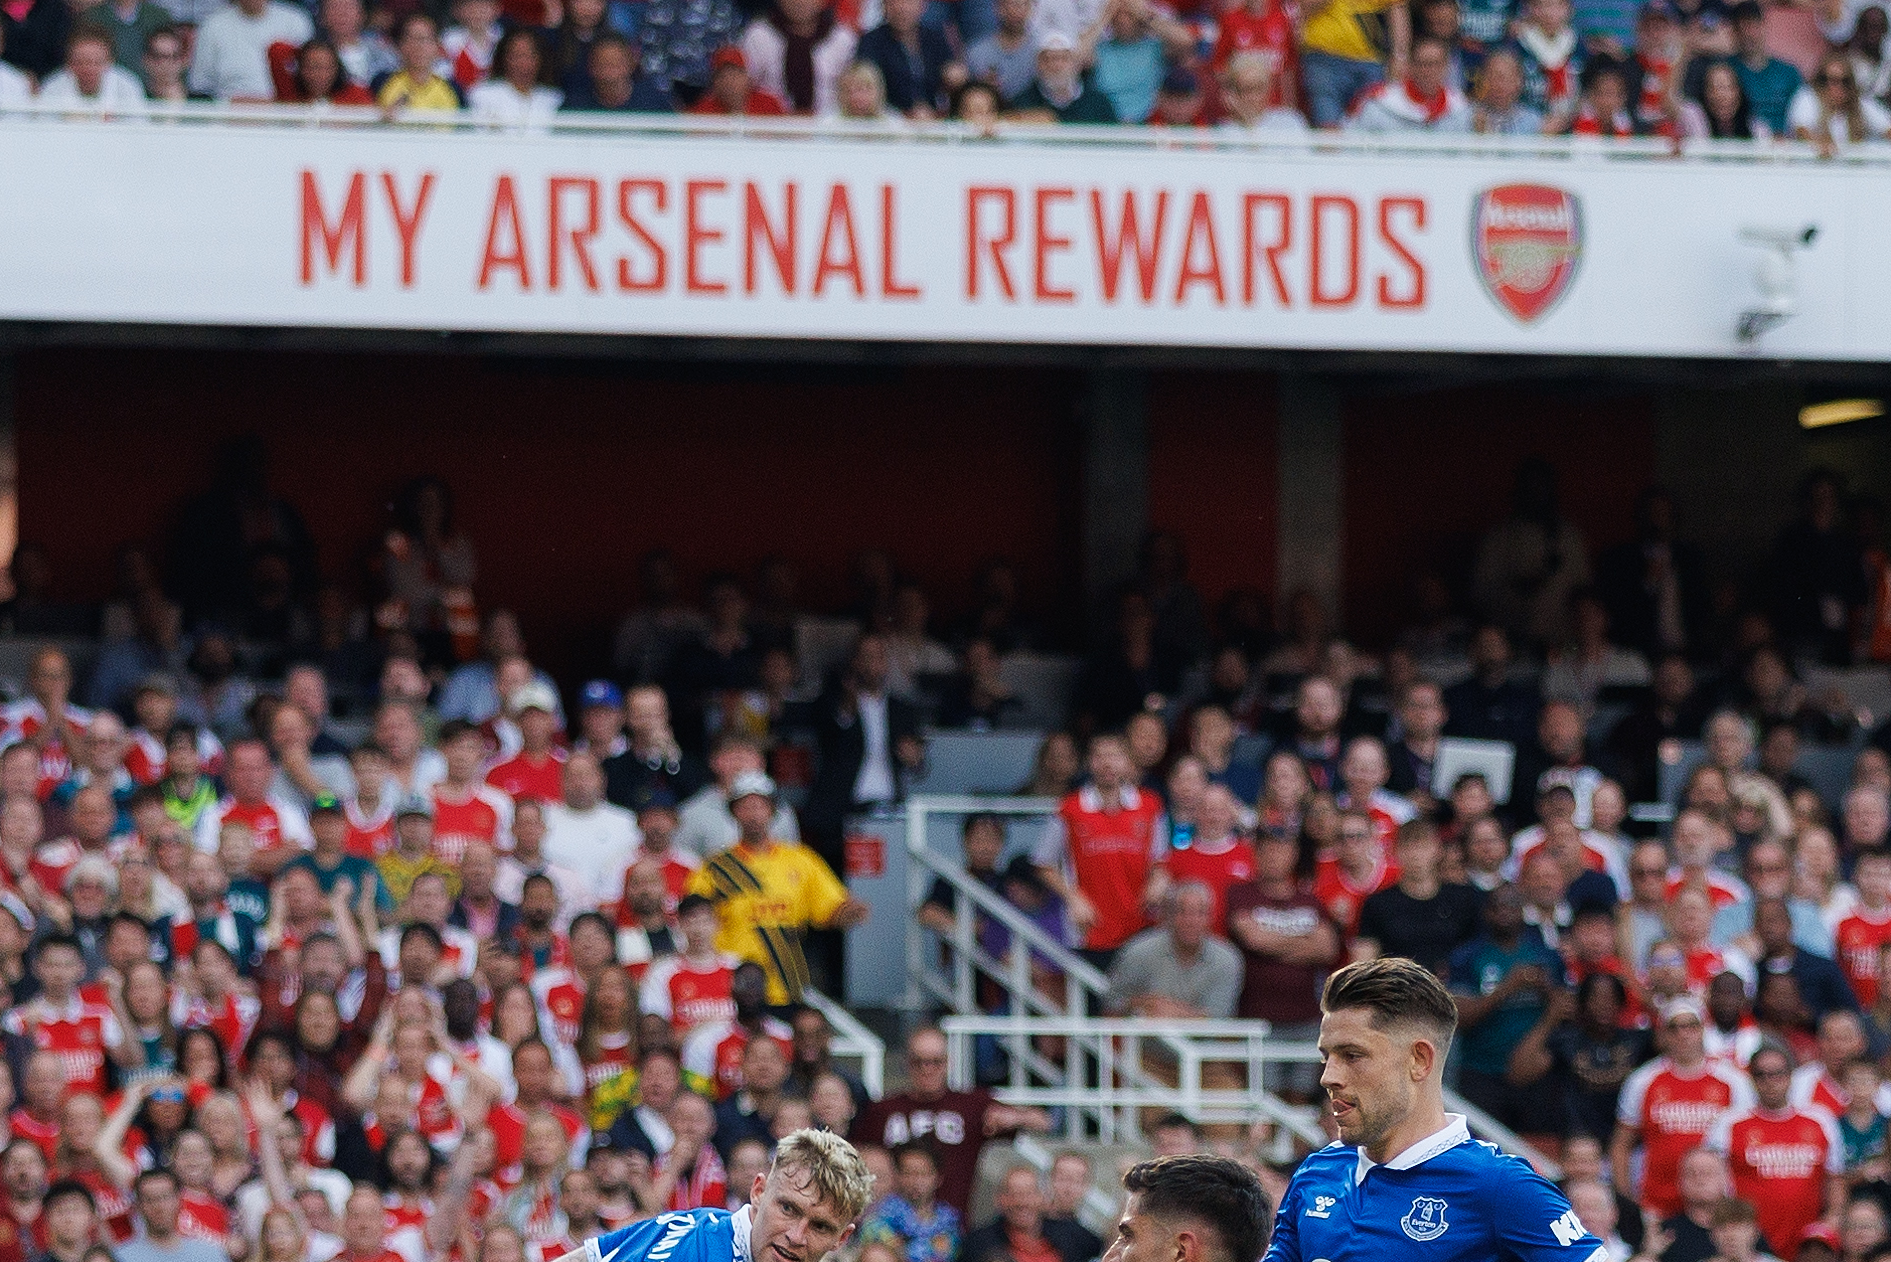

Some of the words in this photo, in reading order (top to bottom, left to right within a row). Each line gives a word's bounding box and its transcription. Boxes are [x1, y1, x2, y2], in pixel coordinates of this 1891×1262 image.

[299, 170, 435, 287] MY
[478, 175, 921, 299] ARSENAL
[966, 185, 1428, 310] REWARDS
[1411, 1219, 1436, 1229] Everton
